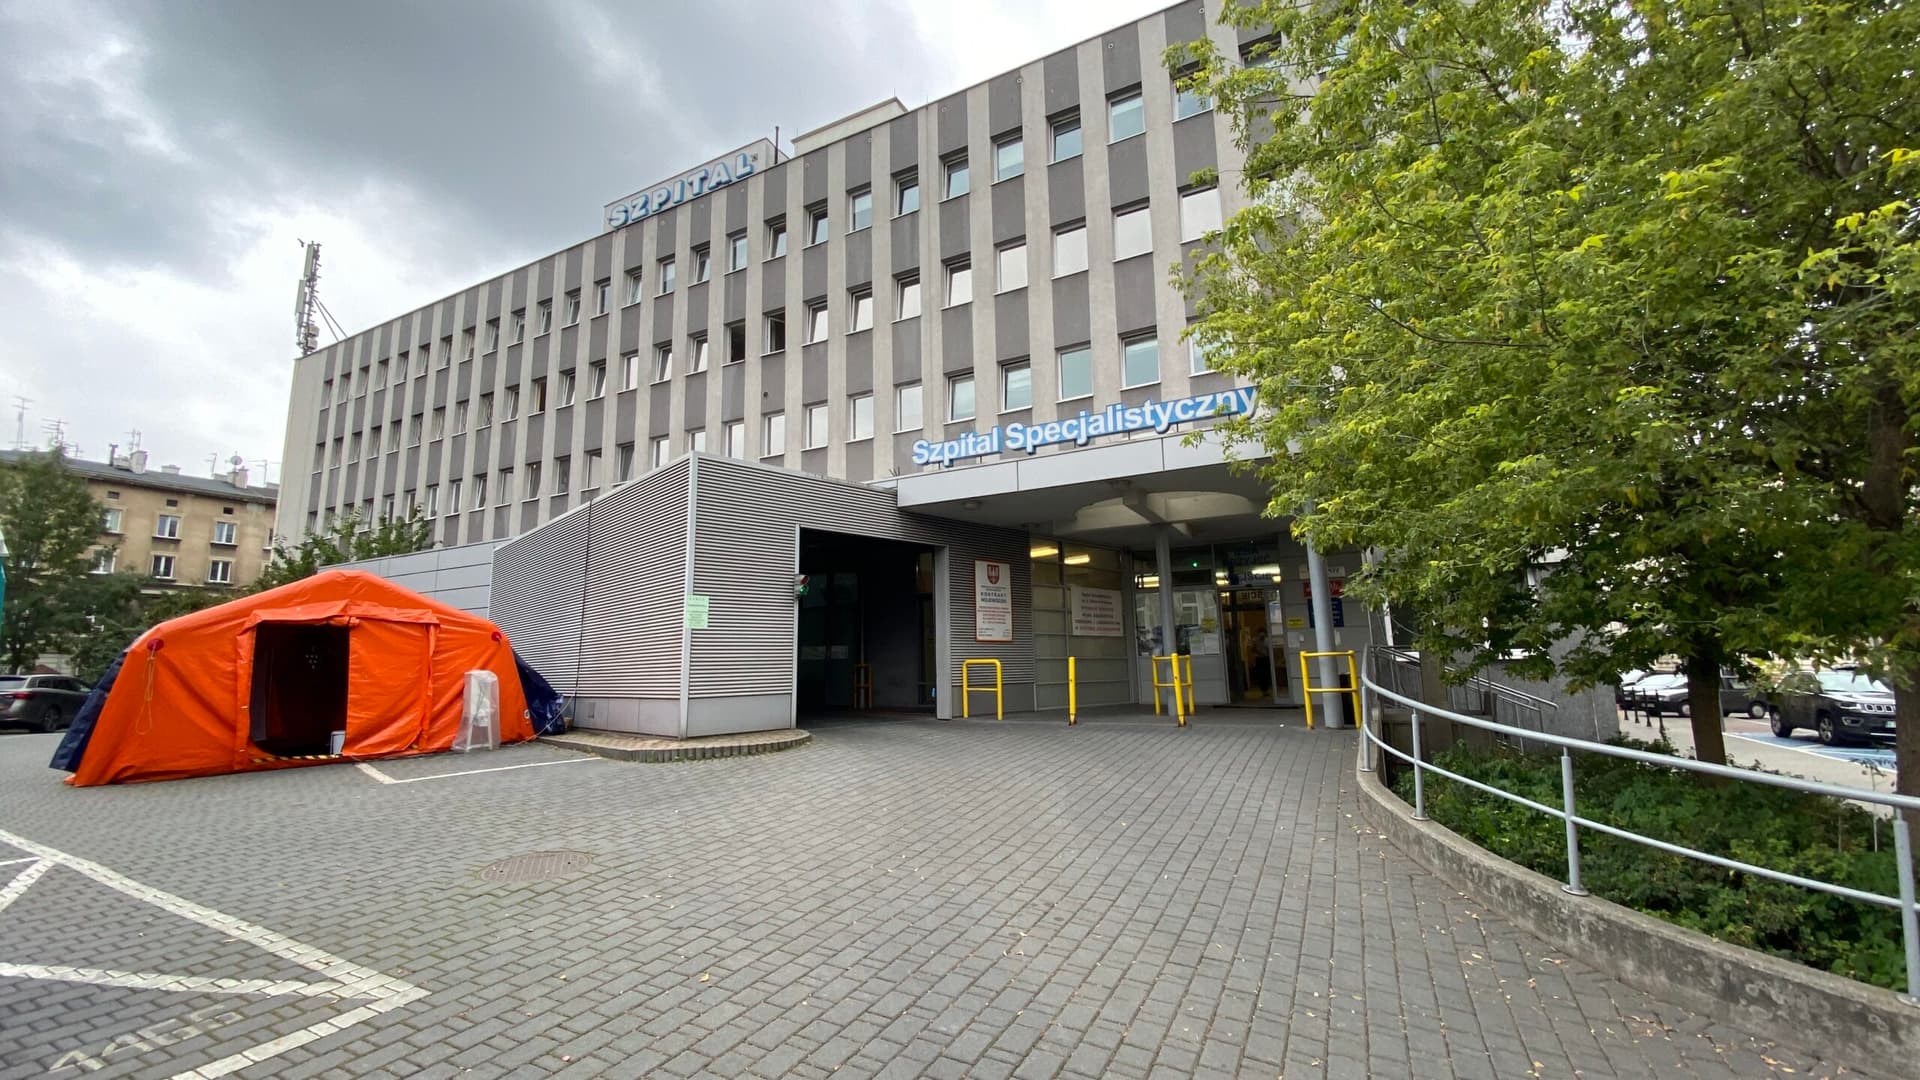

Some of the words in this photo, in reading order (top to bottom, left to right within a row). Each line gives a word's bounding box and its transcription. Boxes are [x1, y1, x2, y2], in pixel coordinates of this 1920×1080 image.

[608, 153, 754, 228] SZPITAL
[912, 427, 1002, 466] Szpital
[1005, 386, 1257, 454] Specjalistyczny
